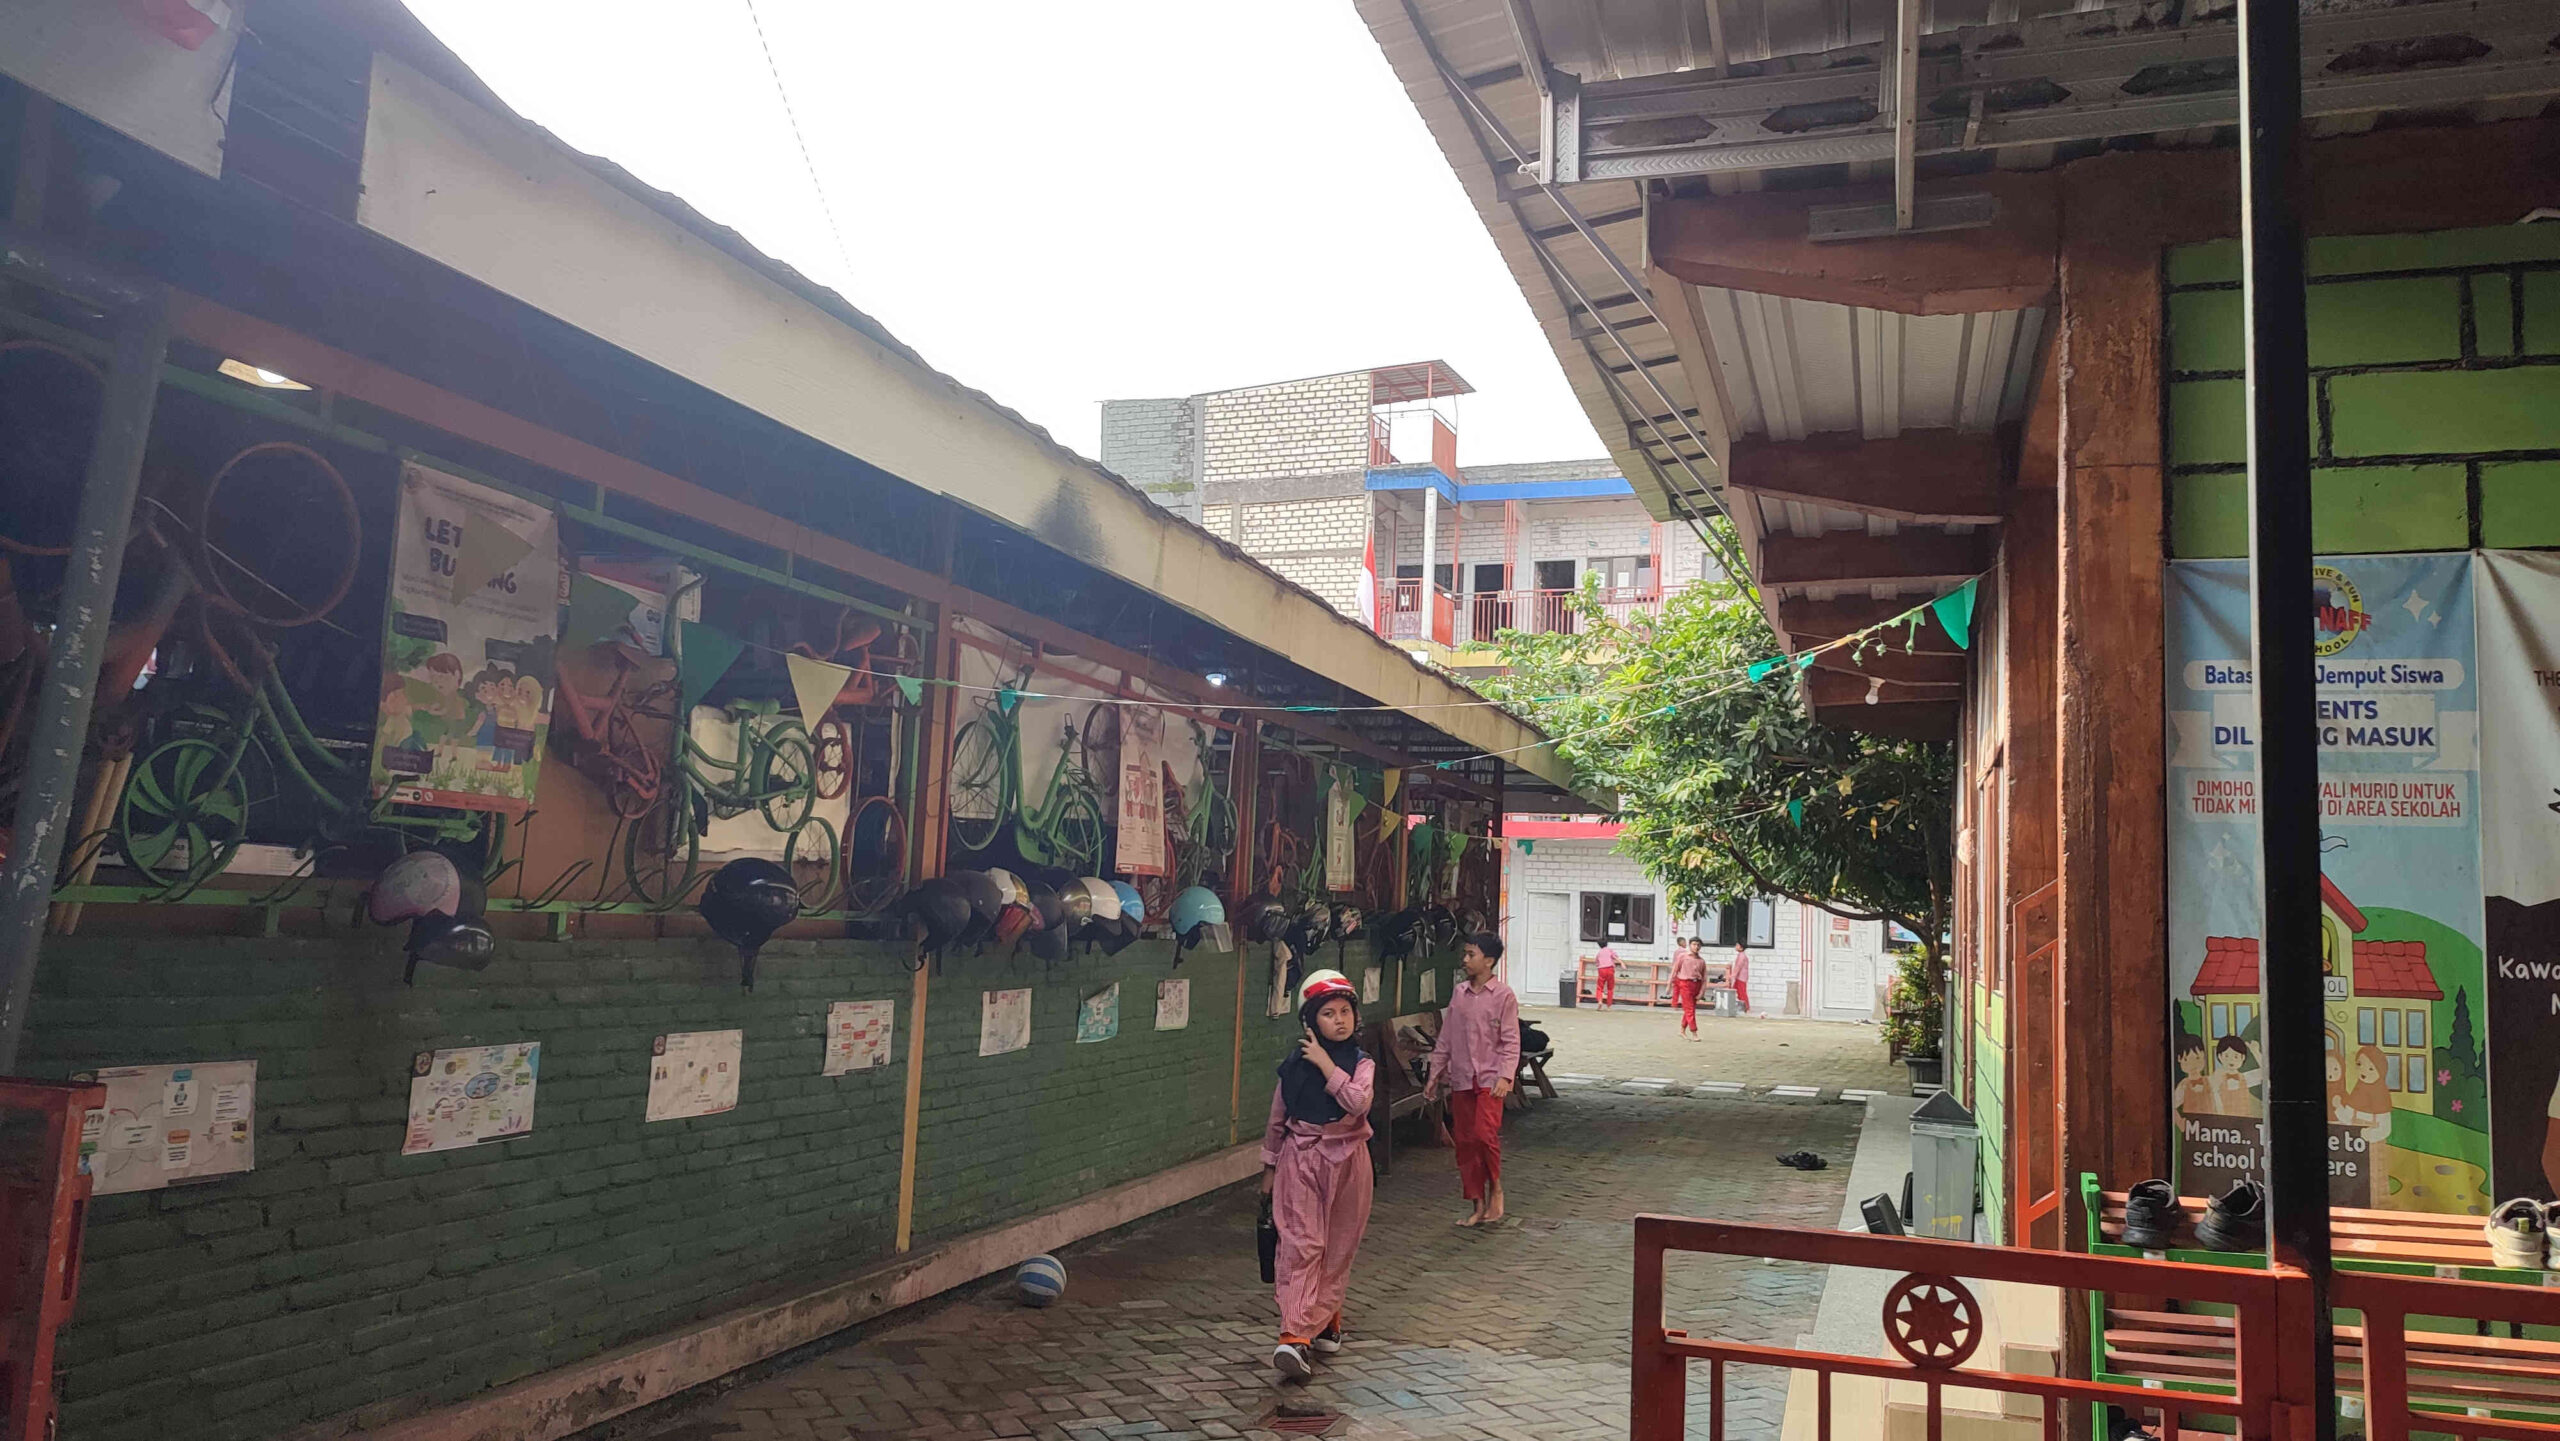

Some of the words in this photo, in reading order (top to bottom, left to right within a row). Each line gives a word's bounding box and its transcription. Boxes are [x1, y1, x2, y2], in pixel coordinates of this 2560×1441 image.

[2314, 638, 2349, 654] HOOL
[2316, 664, 2387, 688] Jemput
[2391, 664, 2444, 684] Siswa
[2317, 700, 2379, 720] ENTS
[2346, 727, 2436, 747] MASUK
[2197, 780, 2255, 797] DIMOHO
[2350, 782, 2399, 799] MURID
[2403, 783, 2456, 800] UNTUK
[2192, 797, 2236, 814] TIDAK
[2327, 800, 2343, 816] DI
[2346, 800, 2387, 817] AREA
[2391, 801, 2461, 818] SEKOLAH
[2185, 1119, 2251, 1146] Mama..
[2344, 1131, 2367, 1153] to
[2192, 1145, 2256, 1170] school
[2327, 1160, 2358, 1178] ere
